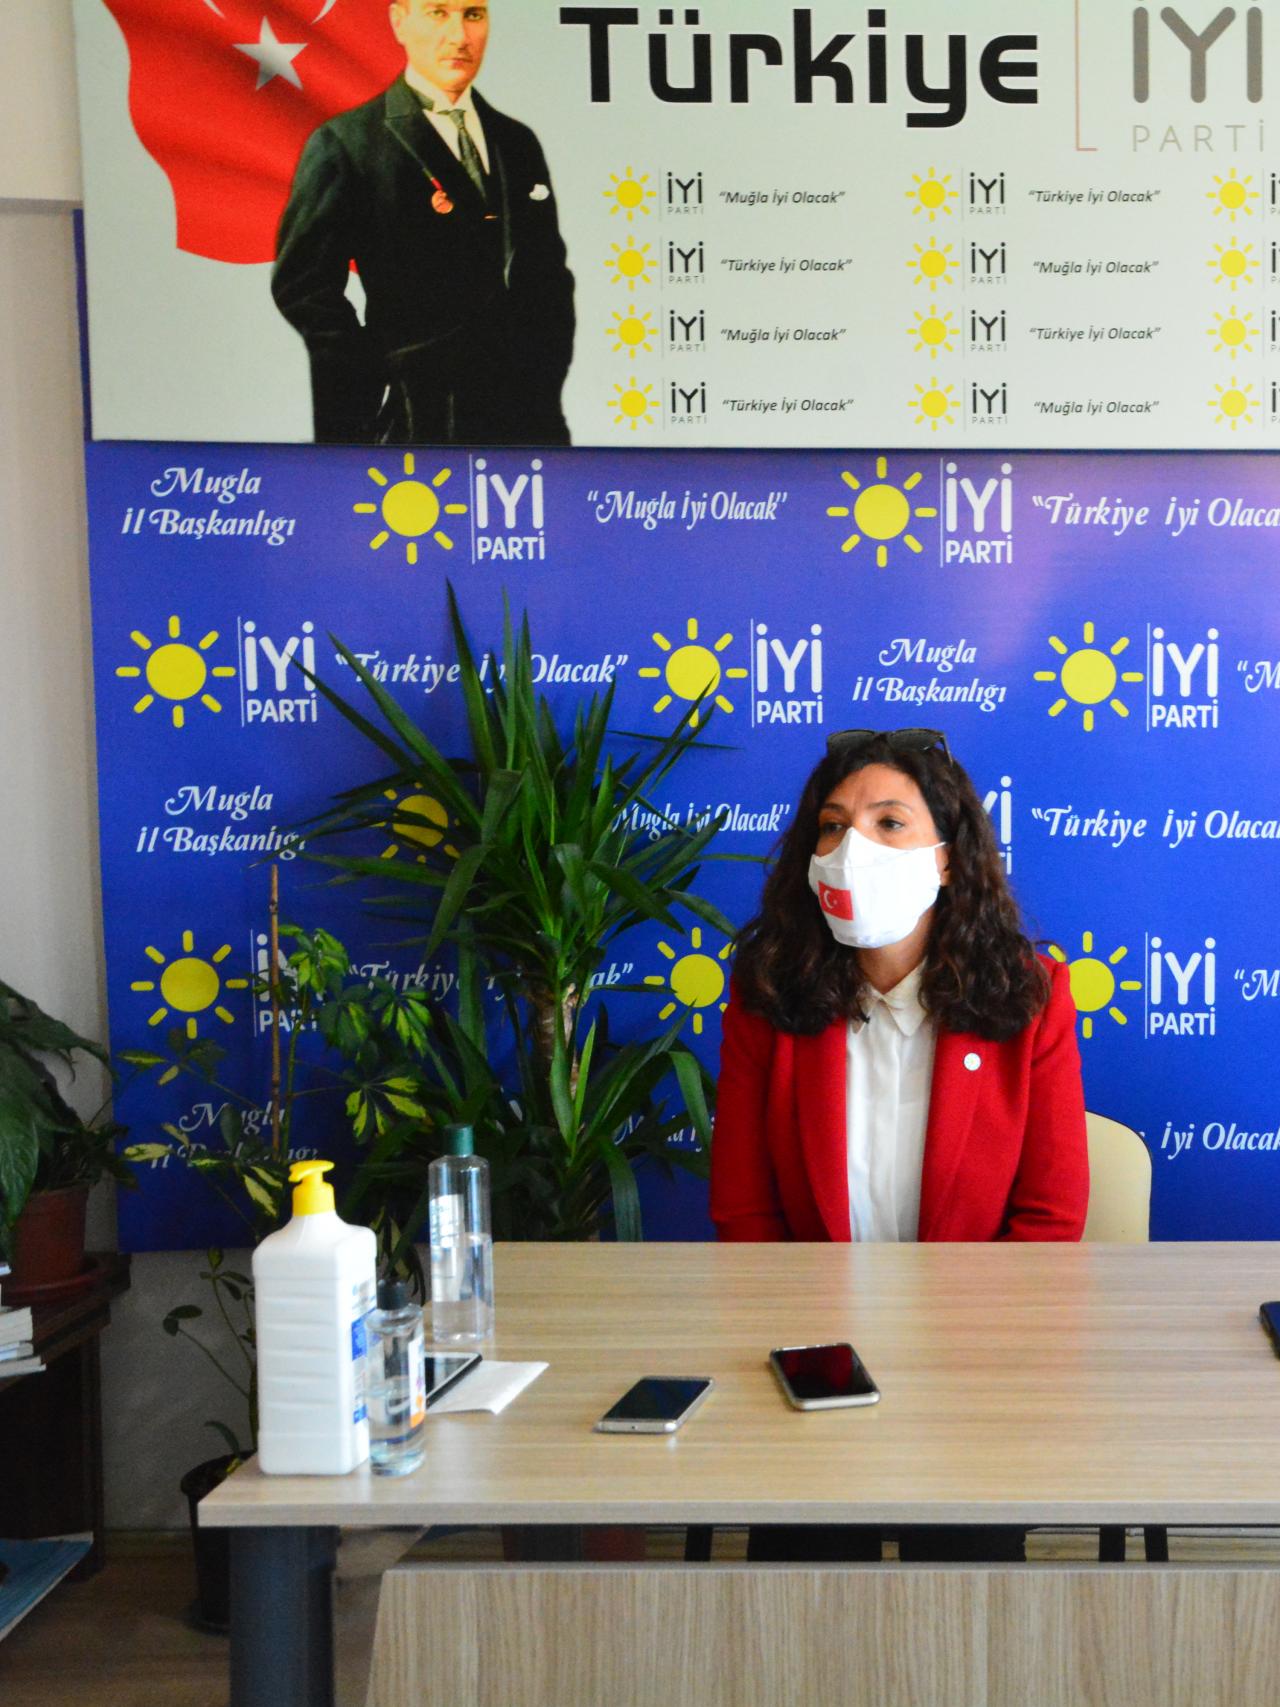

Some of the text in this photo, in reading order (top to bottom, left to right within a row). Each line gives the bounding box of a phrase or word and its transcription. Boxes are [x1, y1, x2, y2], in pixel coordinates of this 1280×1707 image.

[559, 7, 1038, 128] Türkiye
[1132, 119, 1264, 152] PARTİ
[668, 172, 702, 203] İYİ
[970, 172, 1004, 204] İYİ
[669, 241, 703, 273] İYİ
[971, 242, 1005, 273] İYİ
[670, 310, 704, 341] İYİ
[971, 310, 1005, 341] İYİ
[671, 382, 705, 413] İYİ
[973, 383, 1006, 414] İYİ
[476, 459, 543, 529] İYİ
[946, 463, 1012, 533] İYİ
[681, 491, 707, 530] İyi
[1032, 493, 1149, 535] “Türkiye
[1165, 497, 1200, 536] İyi
[475, 534, 545, 562] PARTİ
[946, 535, 1012, 563] PARTİ
[244, 621, 315, 691] İYİ
[756, 624, 822, 693] İYİ
[1153, 628, 1218, 697] İYİ
[247, 690, 317, 722] PARTİ
[757, 695, 823, 723] PARTİ
[1152, 698, 1218, 728] PARTİ
[1032, 807, 1147, 847] “Türkiye
[1163, 809, 1197, 848] İyi
[1151, 937, 1215, 1005] İYİ
[1150, 1006, 1215, 1035] PARTİ
[1161, 1122, 1194, 1159] İyi
